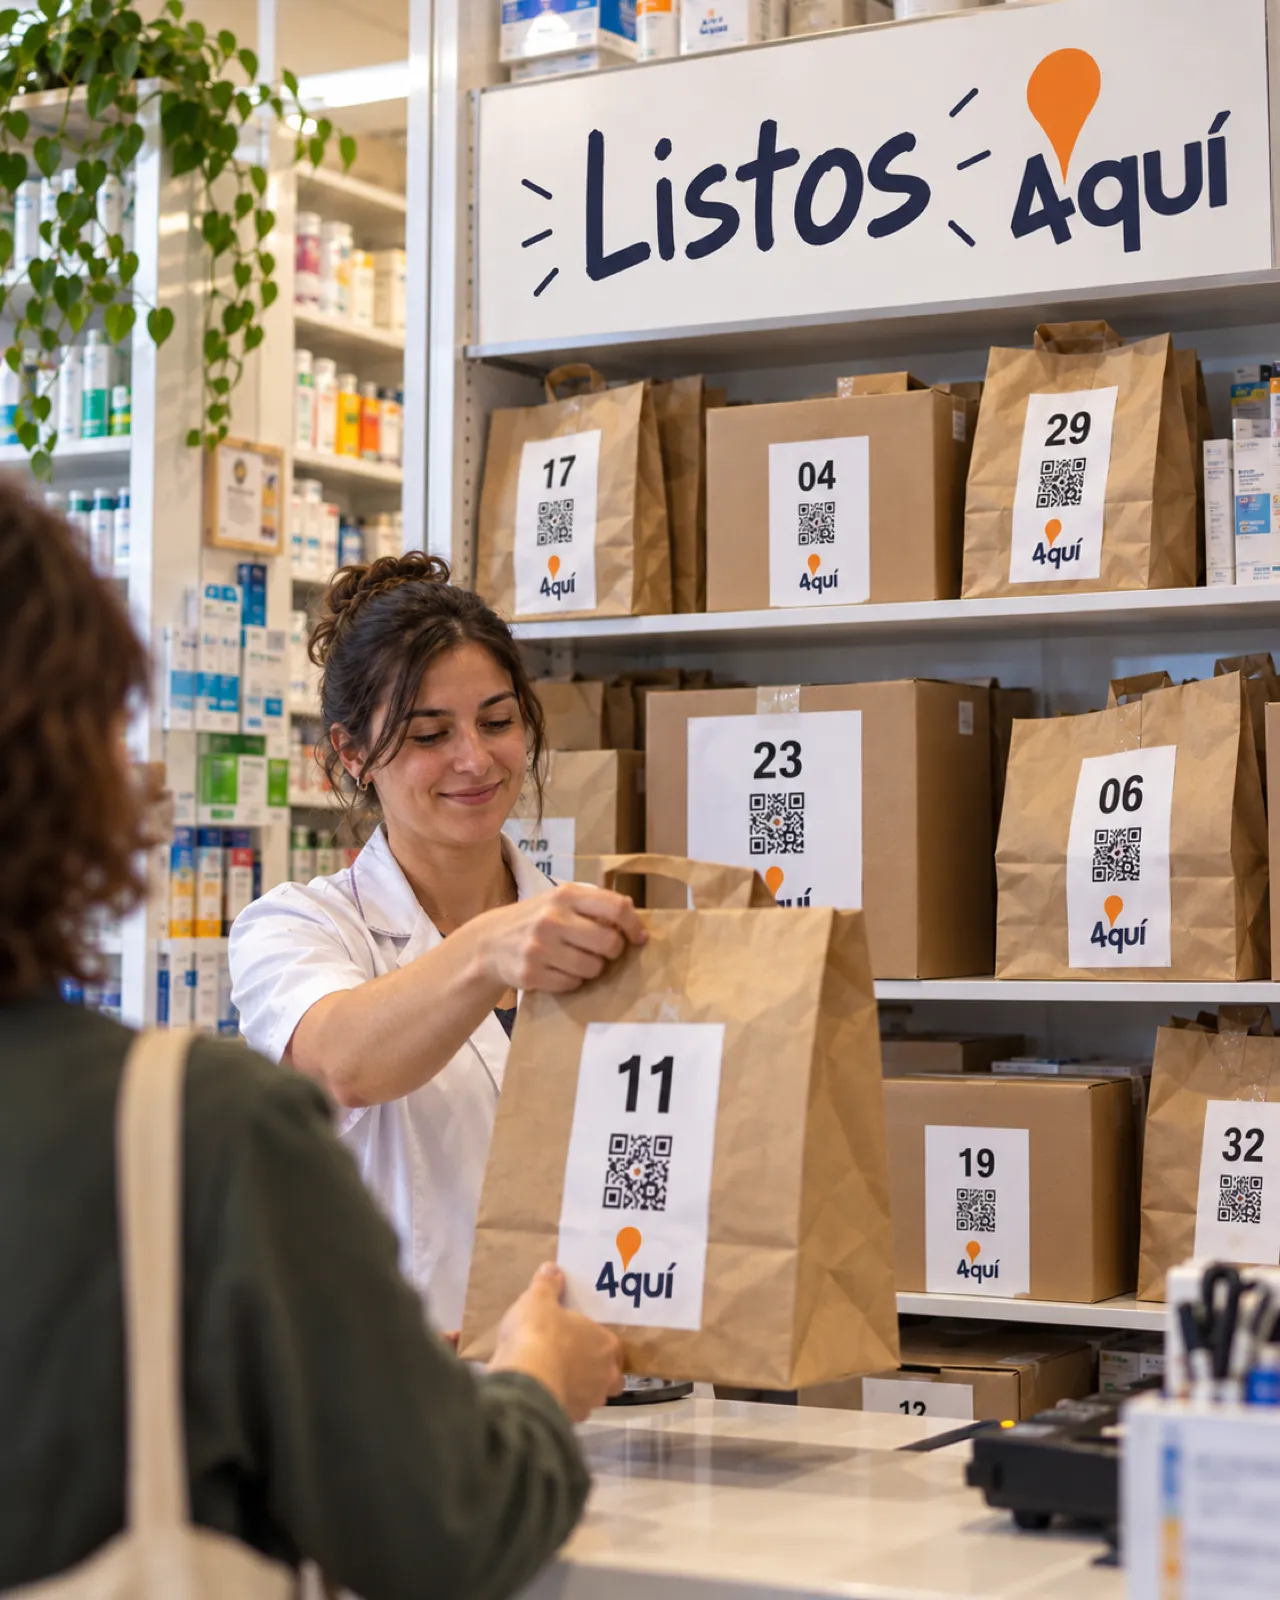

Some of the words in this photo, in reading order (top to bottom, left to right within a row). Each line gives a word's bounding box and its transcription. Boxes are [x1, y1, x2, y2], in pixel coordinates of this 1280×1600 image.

[585, 118, 932, 282] Listos
[1044, 411, 1092, 447] 29
[543, 454, 576, 489] 17
[798, 459, 837, 492] 04
[753, 739, 803, 780] 23
[1099, 774, 1144, 815] 06
[617, 1054, 675, 1114] 11
[958, 1147, 996, 1179] 19
[1221, 1126, 1265, 1163] 32
